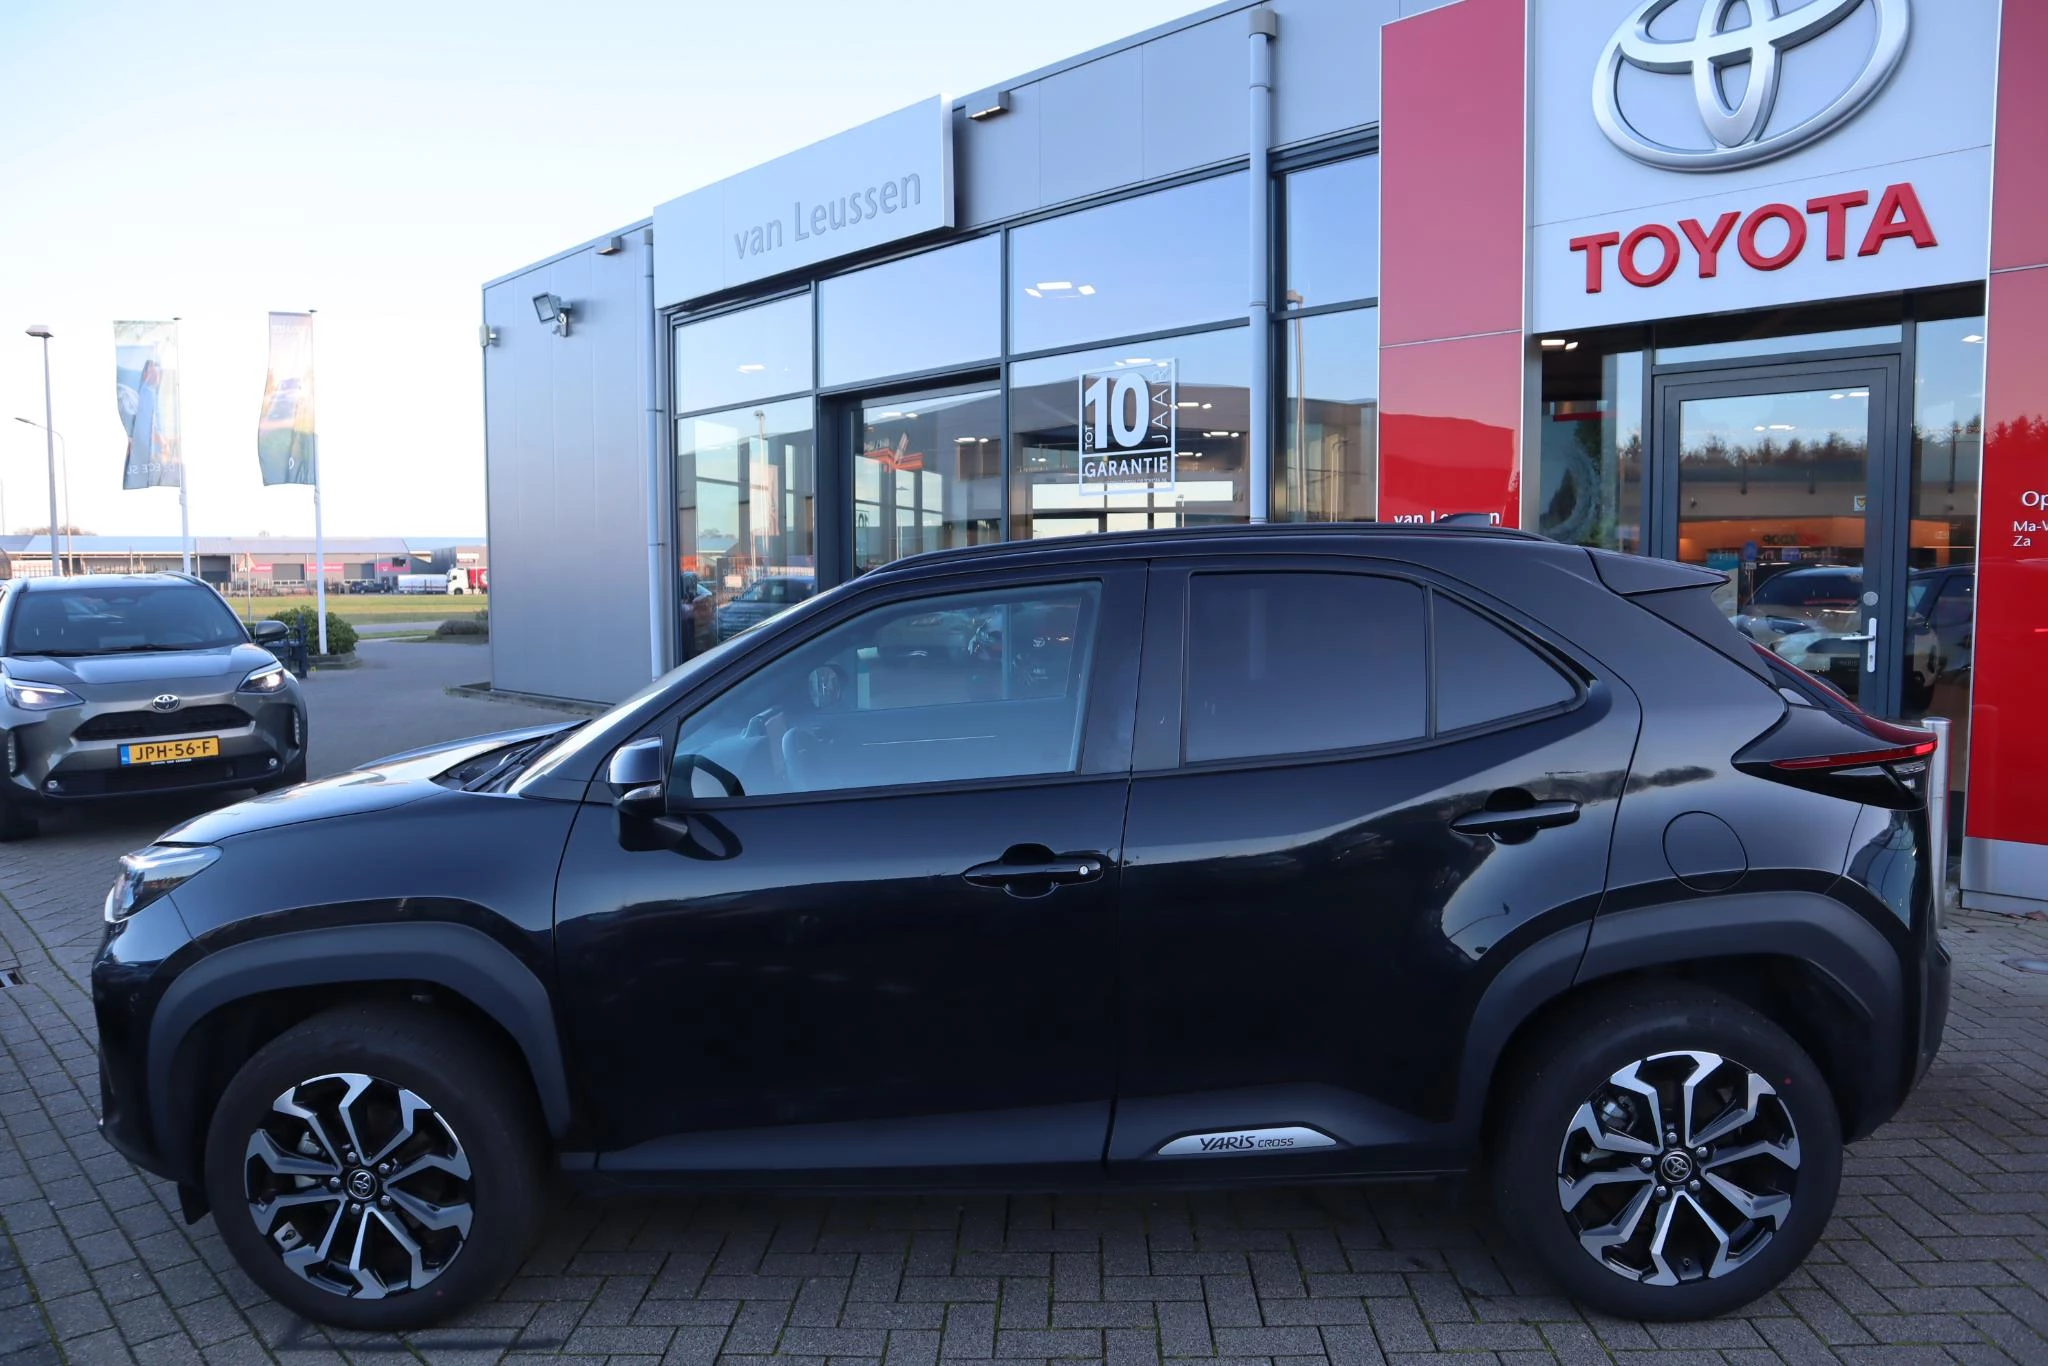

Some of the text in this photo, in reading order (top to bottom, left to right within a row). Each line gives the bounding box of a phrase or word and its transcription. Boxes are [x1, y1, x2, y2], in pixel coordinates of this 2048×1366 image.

[733, 171, 922, 260] van Leussen
[1569, 182, 1938, 294] TOYOTA
[1084, 372, 1150, 449] 10
[1084, 425, 1094, 450] TOT
[1084, 455, 1168, 478] GARANTIE
[2013, 535, 2031, 547] Za
[135, 740, 211, 761] JPH-56-F
[1258, 1137, 1294, 1148] CROSS
